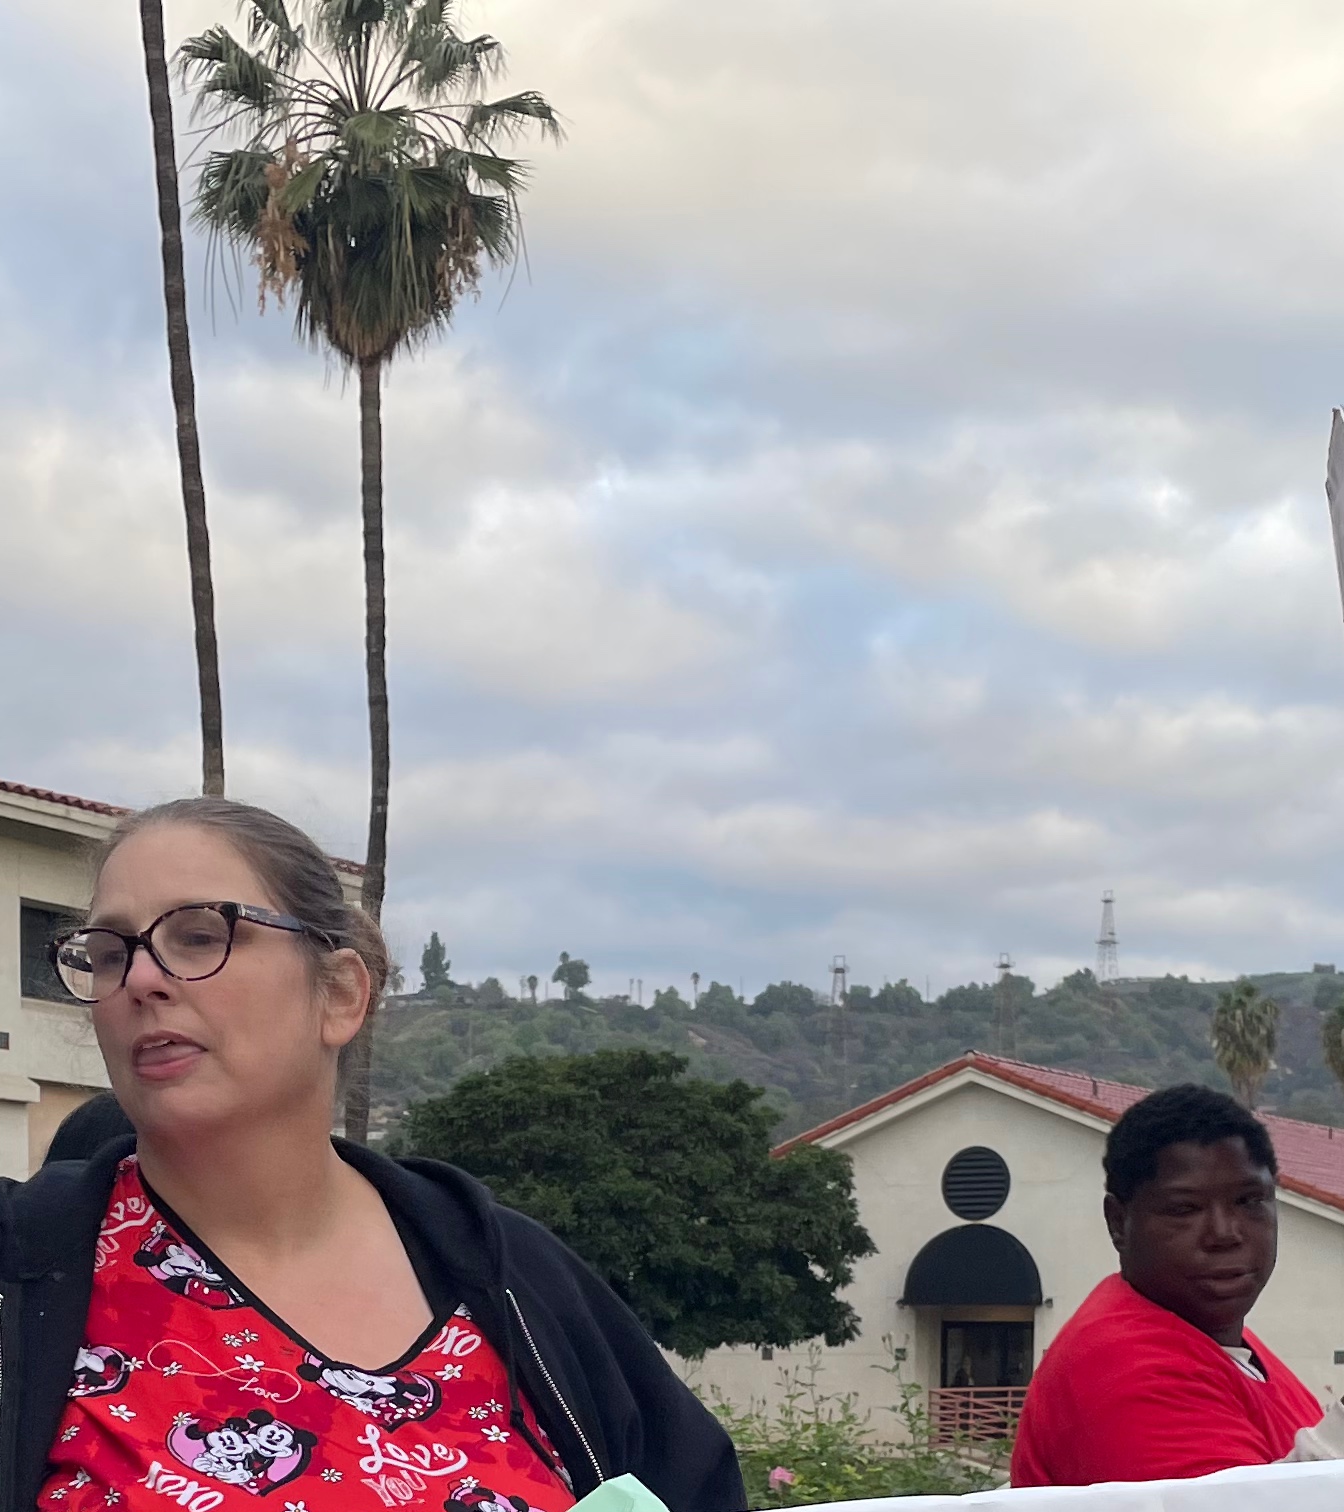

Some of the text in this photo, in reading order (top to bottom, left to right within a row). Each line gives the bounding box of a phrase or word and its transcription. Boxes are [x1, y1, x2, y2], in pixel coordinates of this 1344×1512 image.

[238, 1376, 281, 1402] Love
[357, 1424, 468, 1475] Love
[137, 1460, 224, 1512] XOXO
